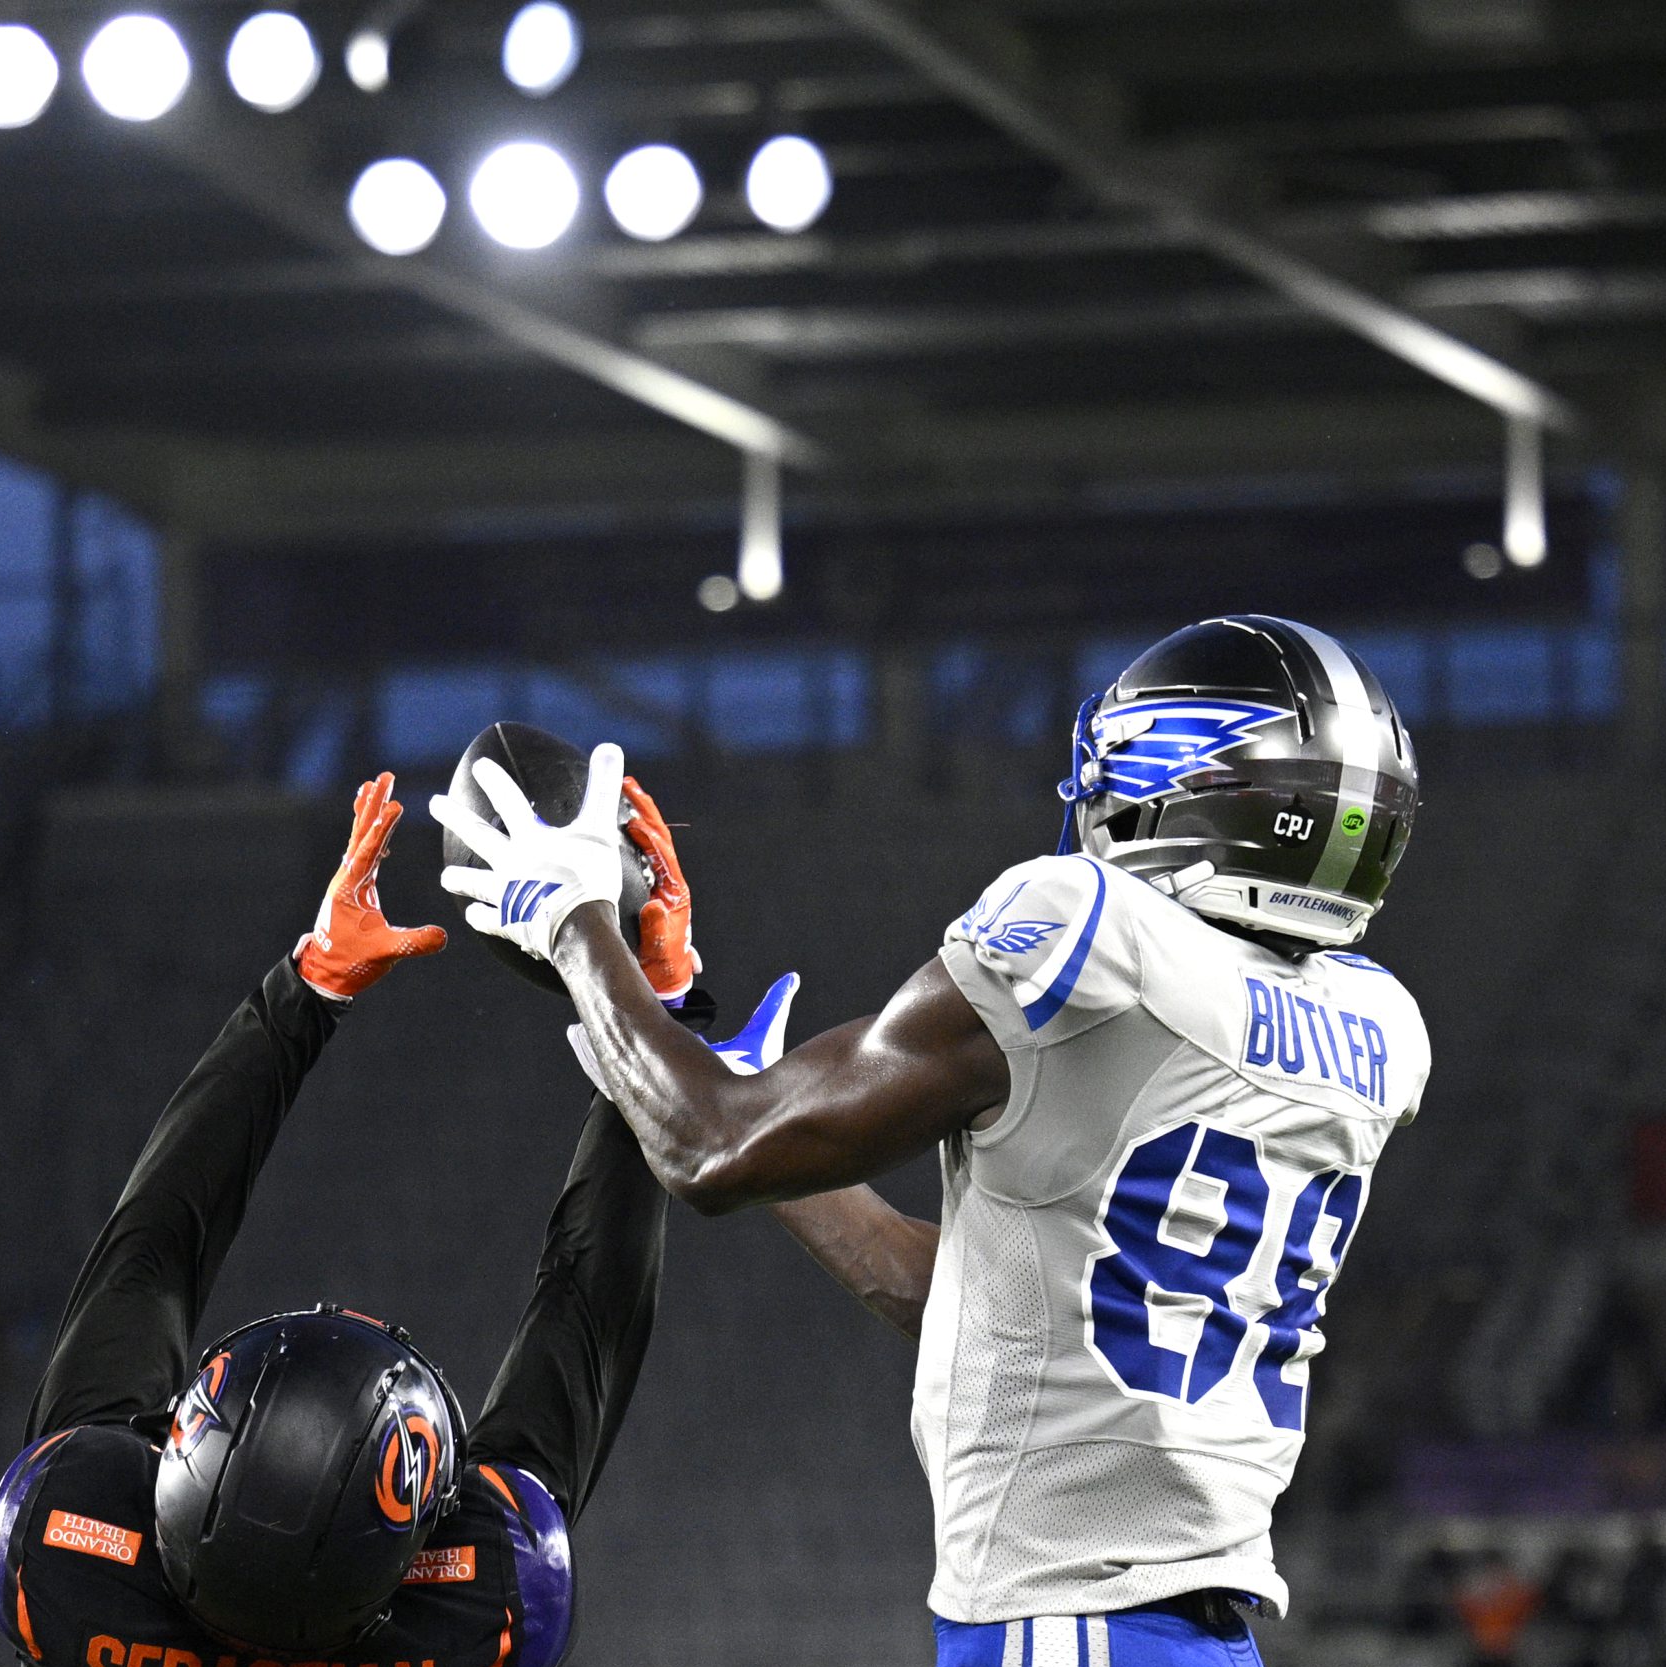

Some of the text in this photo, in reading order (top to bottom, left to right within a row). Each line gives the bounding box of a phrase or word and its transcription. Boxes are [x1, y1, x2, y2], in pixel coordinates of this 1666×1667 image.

[1274, 812, 1314, 840] CPJ
[1269, 892, 1356, 921] BATTLEHAWKS
[1246, 977, 1387, 1106] BUTLER
[61, 1514, 127, 1544] HEALTH
[50, 1529, 132, 1560] ORLANDO
